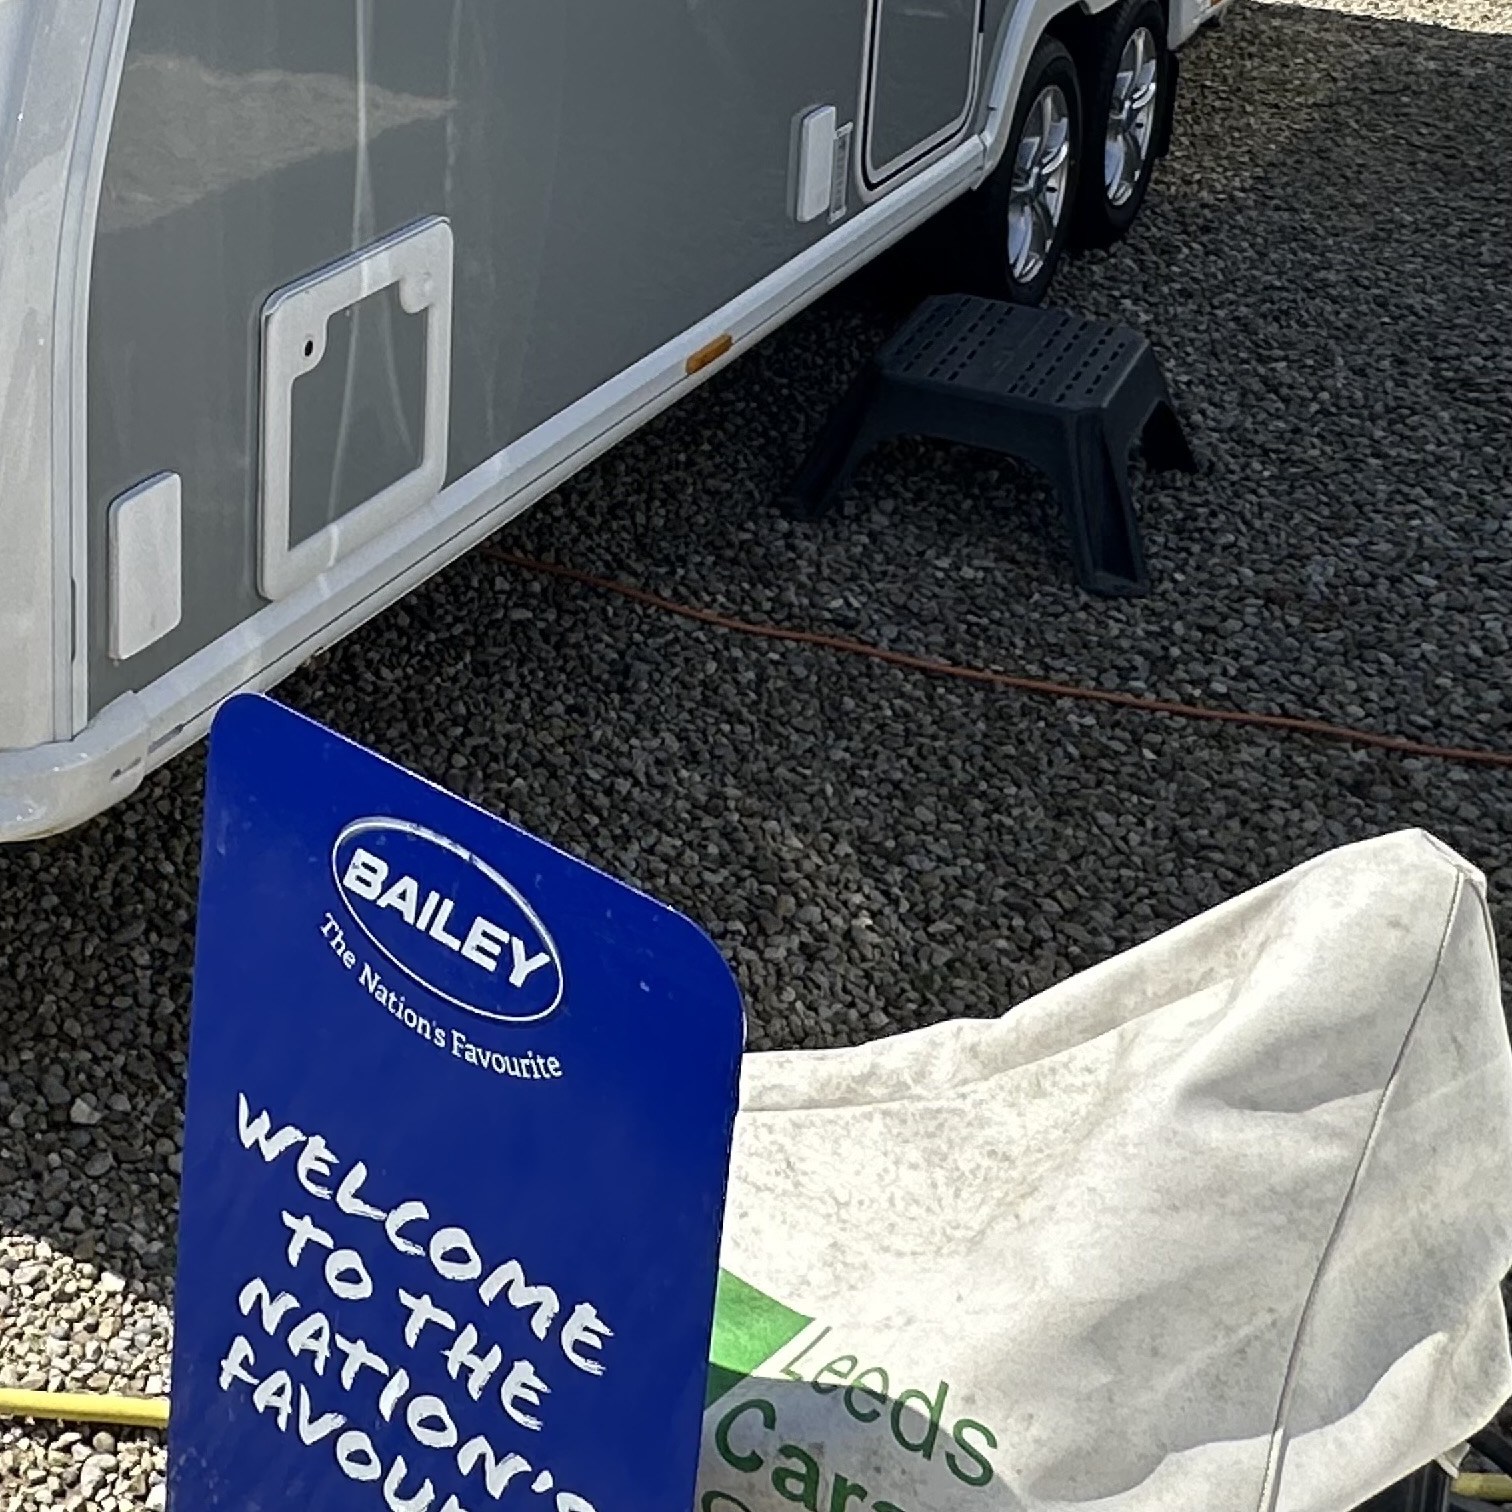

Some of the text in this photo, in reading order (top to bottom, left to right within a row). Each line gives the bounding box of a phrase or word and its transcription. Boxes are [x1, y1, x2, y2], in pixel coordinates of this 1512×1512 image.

[319, 911, 564, 1080] The Nation's Favourite
[342, 847, 552, 989] BAILEY
[237, 1091, 615, 1376] WELCOME
[280, 1209, 552, 1432] TO THE
[714, 1398, 912, 1512] Car
[779, 1324, 999, 1487] Leeds
